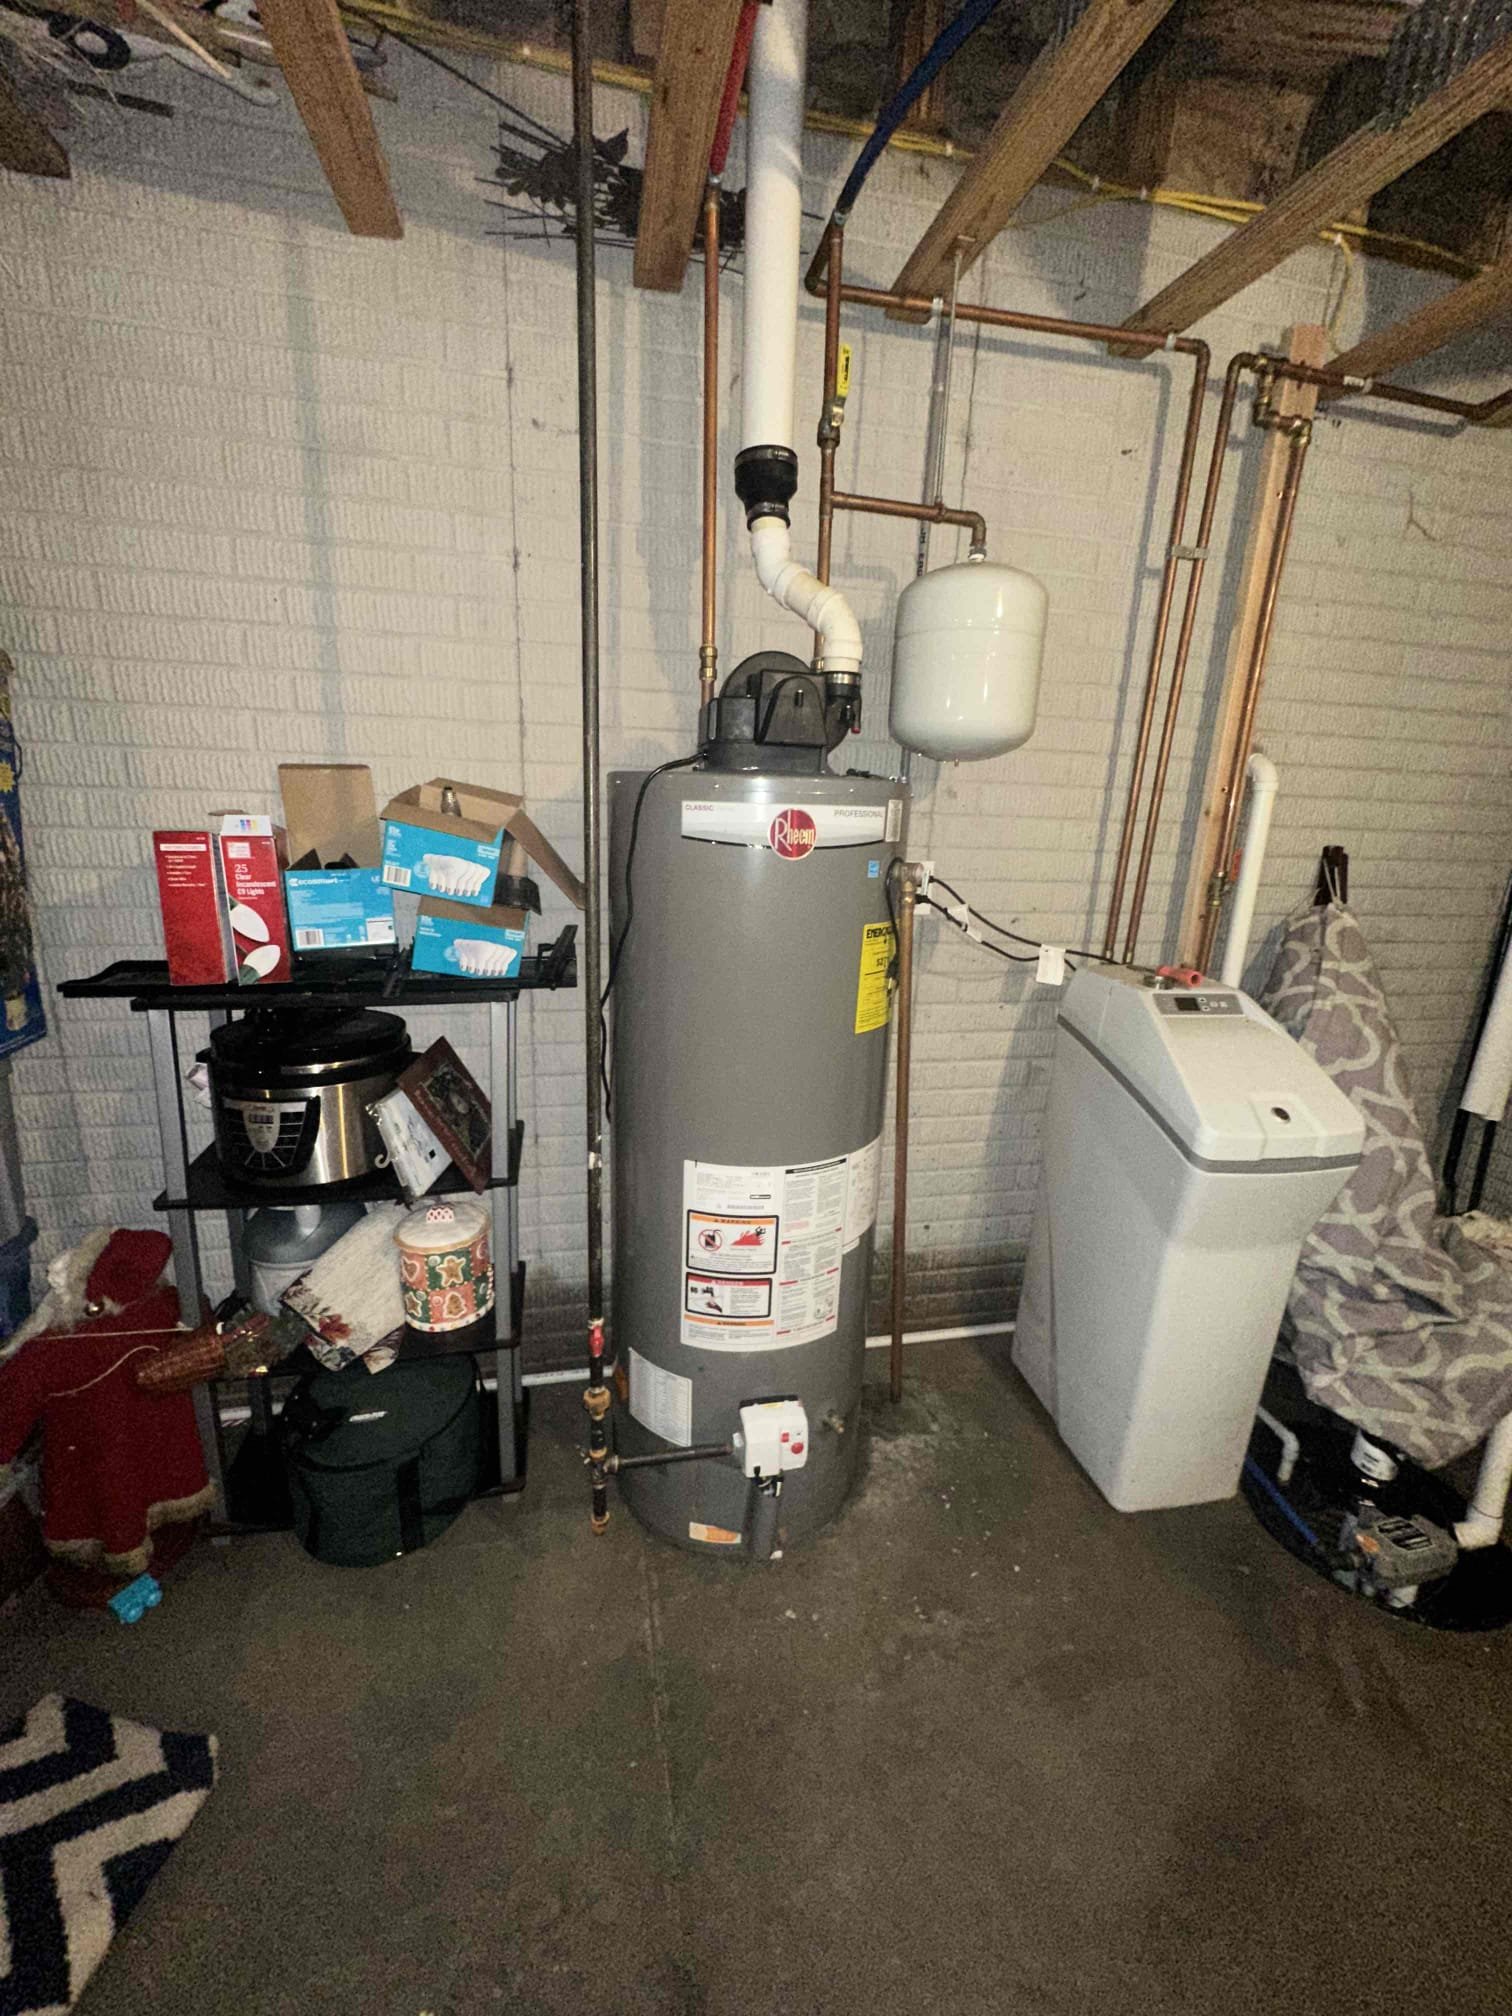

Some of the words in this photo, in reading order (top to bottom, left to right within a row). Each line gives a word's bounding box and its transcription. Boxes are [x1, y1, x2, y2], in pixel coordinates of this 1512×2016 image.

[833, 809, 883, 818] PROFESSIONAL
[774, 809, 815, 851] Rheem
[234, 864, 248, 873] 25
[298, 877, 338, 885] ecosmart
